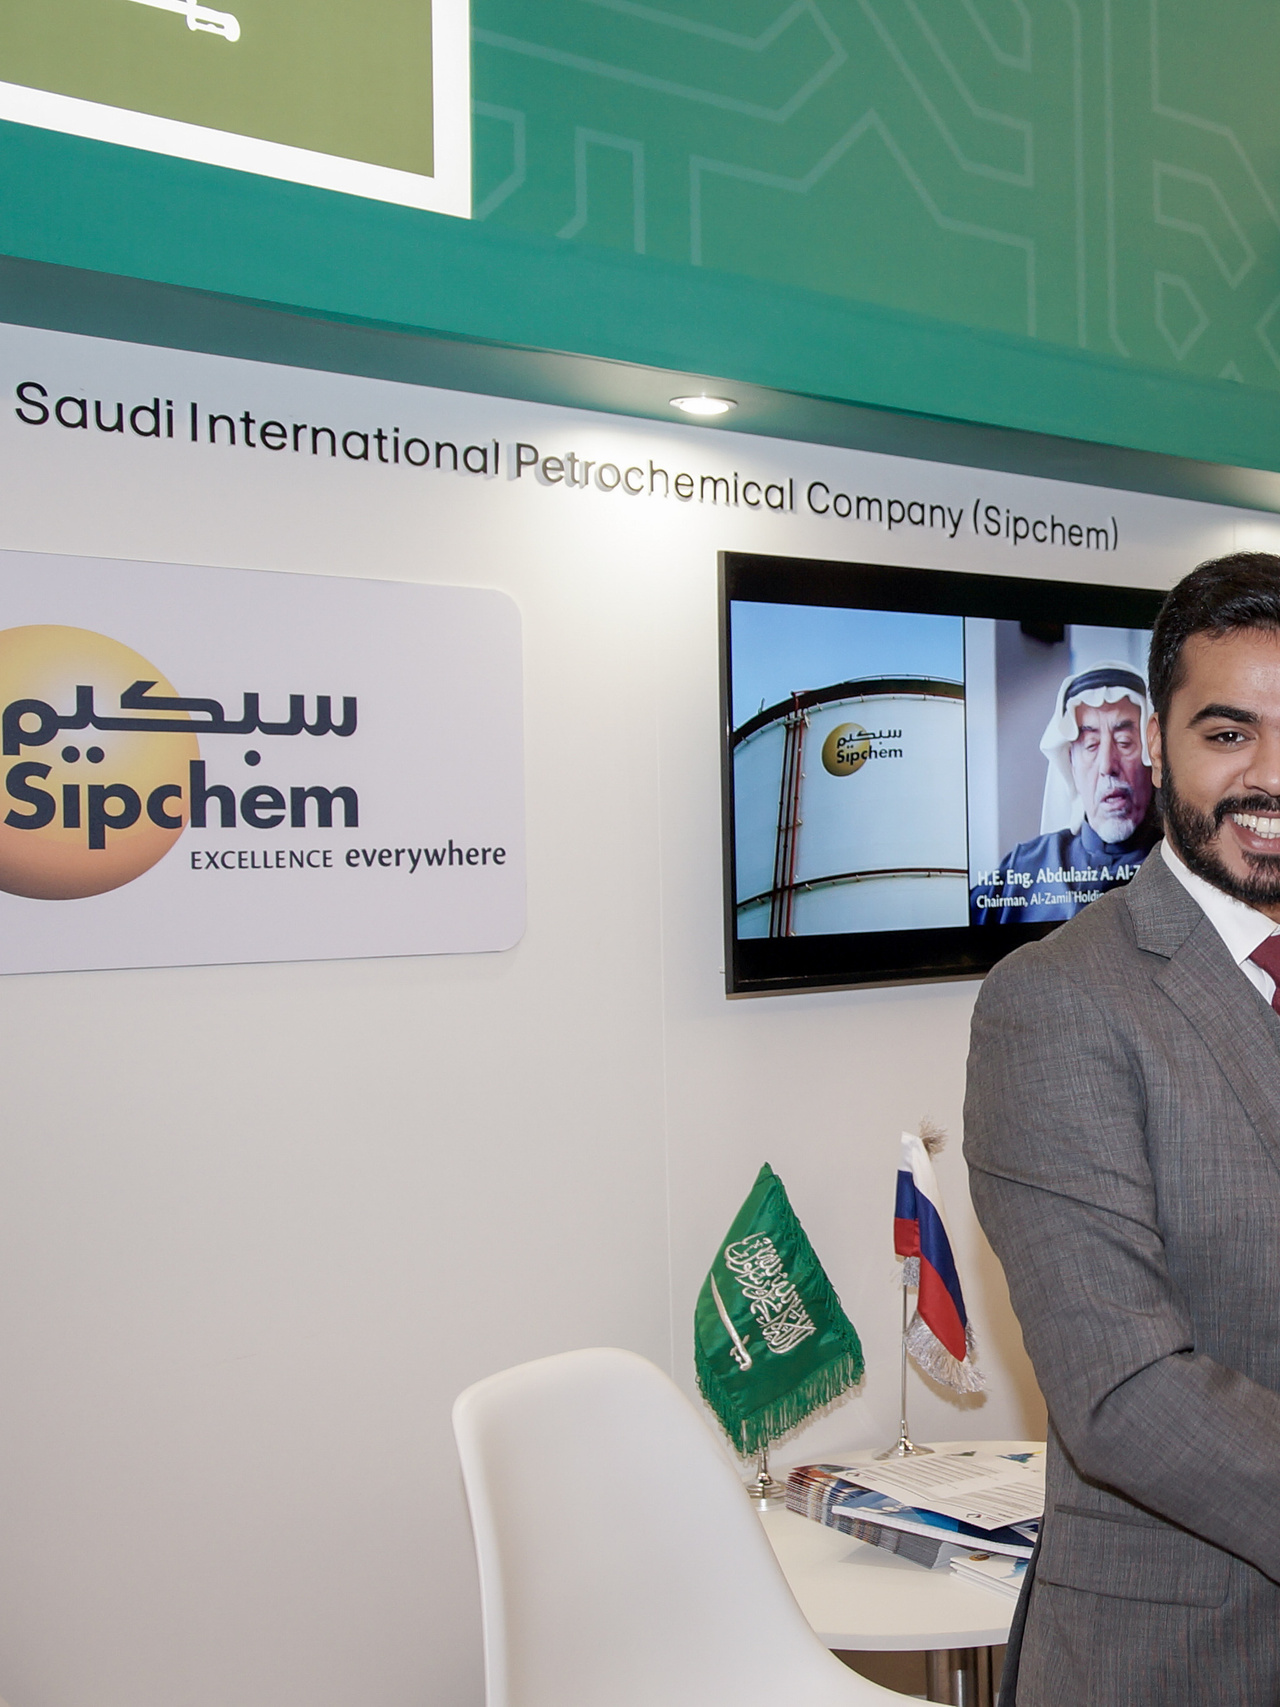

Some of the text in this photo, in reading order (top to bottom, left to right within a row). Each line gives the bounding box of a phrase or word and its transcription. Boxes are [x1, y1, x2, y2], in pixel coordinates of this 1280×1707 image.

[15, 381, 1118, 550] Saudi International Petrochemical Company (Sipchem)
[2, 680, 358, 767] سبكيم
[837, 729, 902, 749] سبكيم
[837, 745, 903, 765] Sipchem
[3, 760, 360, 849] Sipchem
[191, 840, 507, 873] EXCELLENCE everywhere
[977, 863, 1141, 889] H.E. Eng. Abdulaziz A. Al-Z
[976, 889, 1104, 909] Chairman, Al-Zamil Holdi
